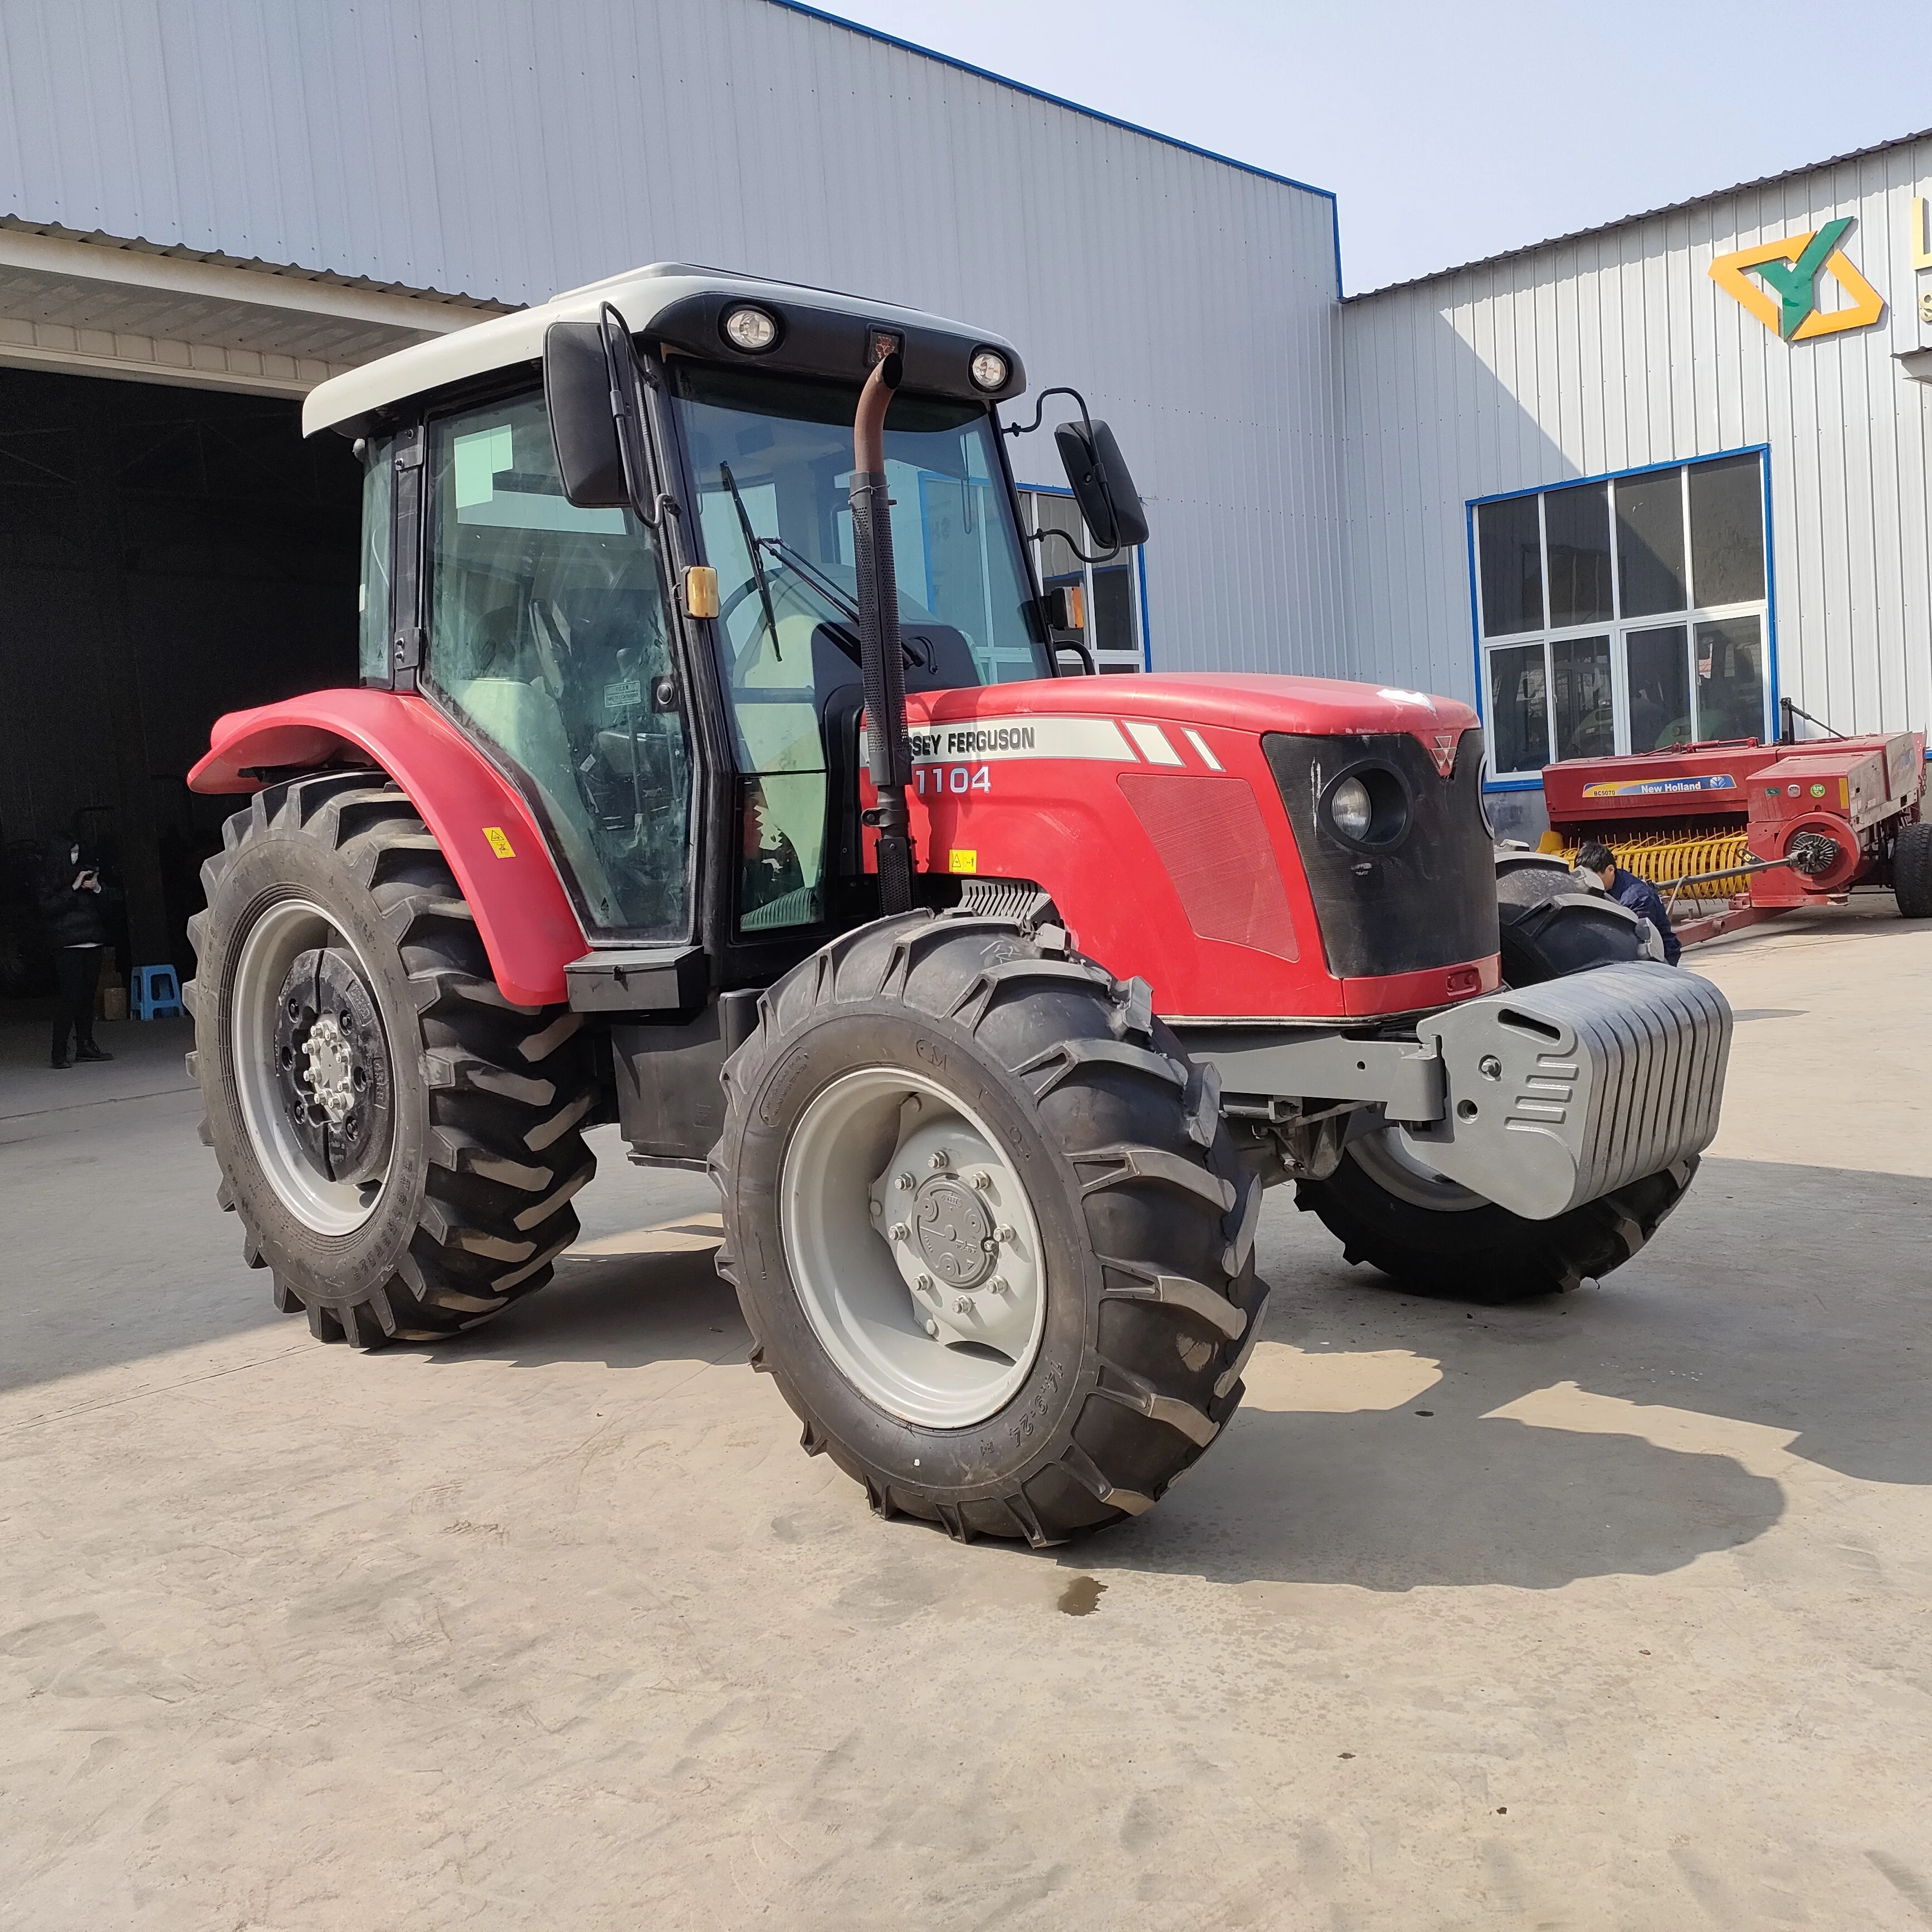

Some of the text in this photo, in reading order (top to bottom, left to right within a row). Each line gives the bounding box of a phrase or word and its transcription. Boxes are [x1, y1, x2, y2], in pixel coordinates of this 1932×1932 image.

[909, 726, 1035, 757] SEY FERGUSON
[915, 765, 992, 794] 1104
[1641, 782, 1701, 793] New Holland
